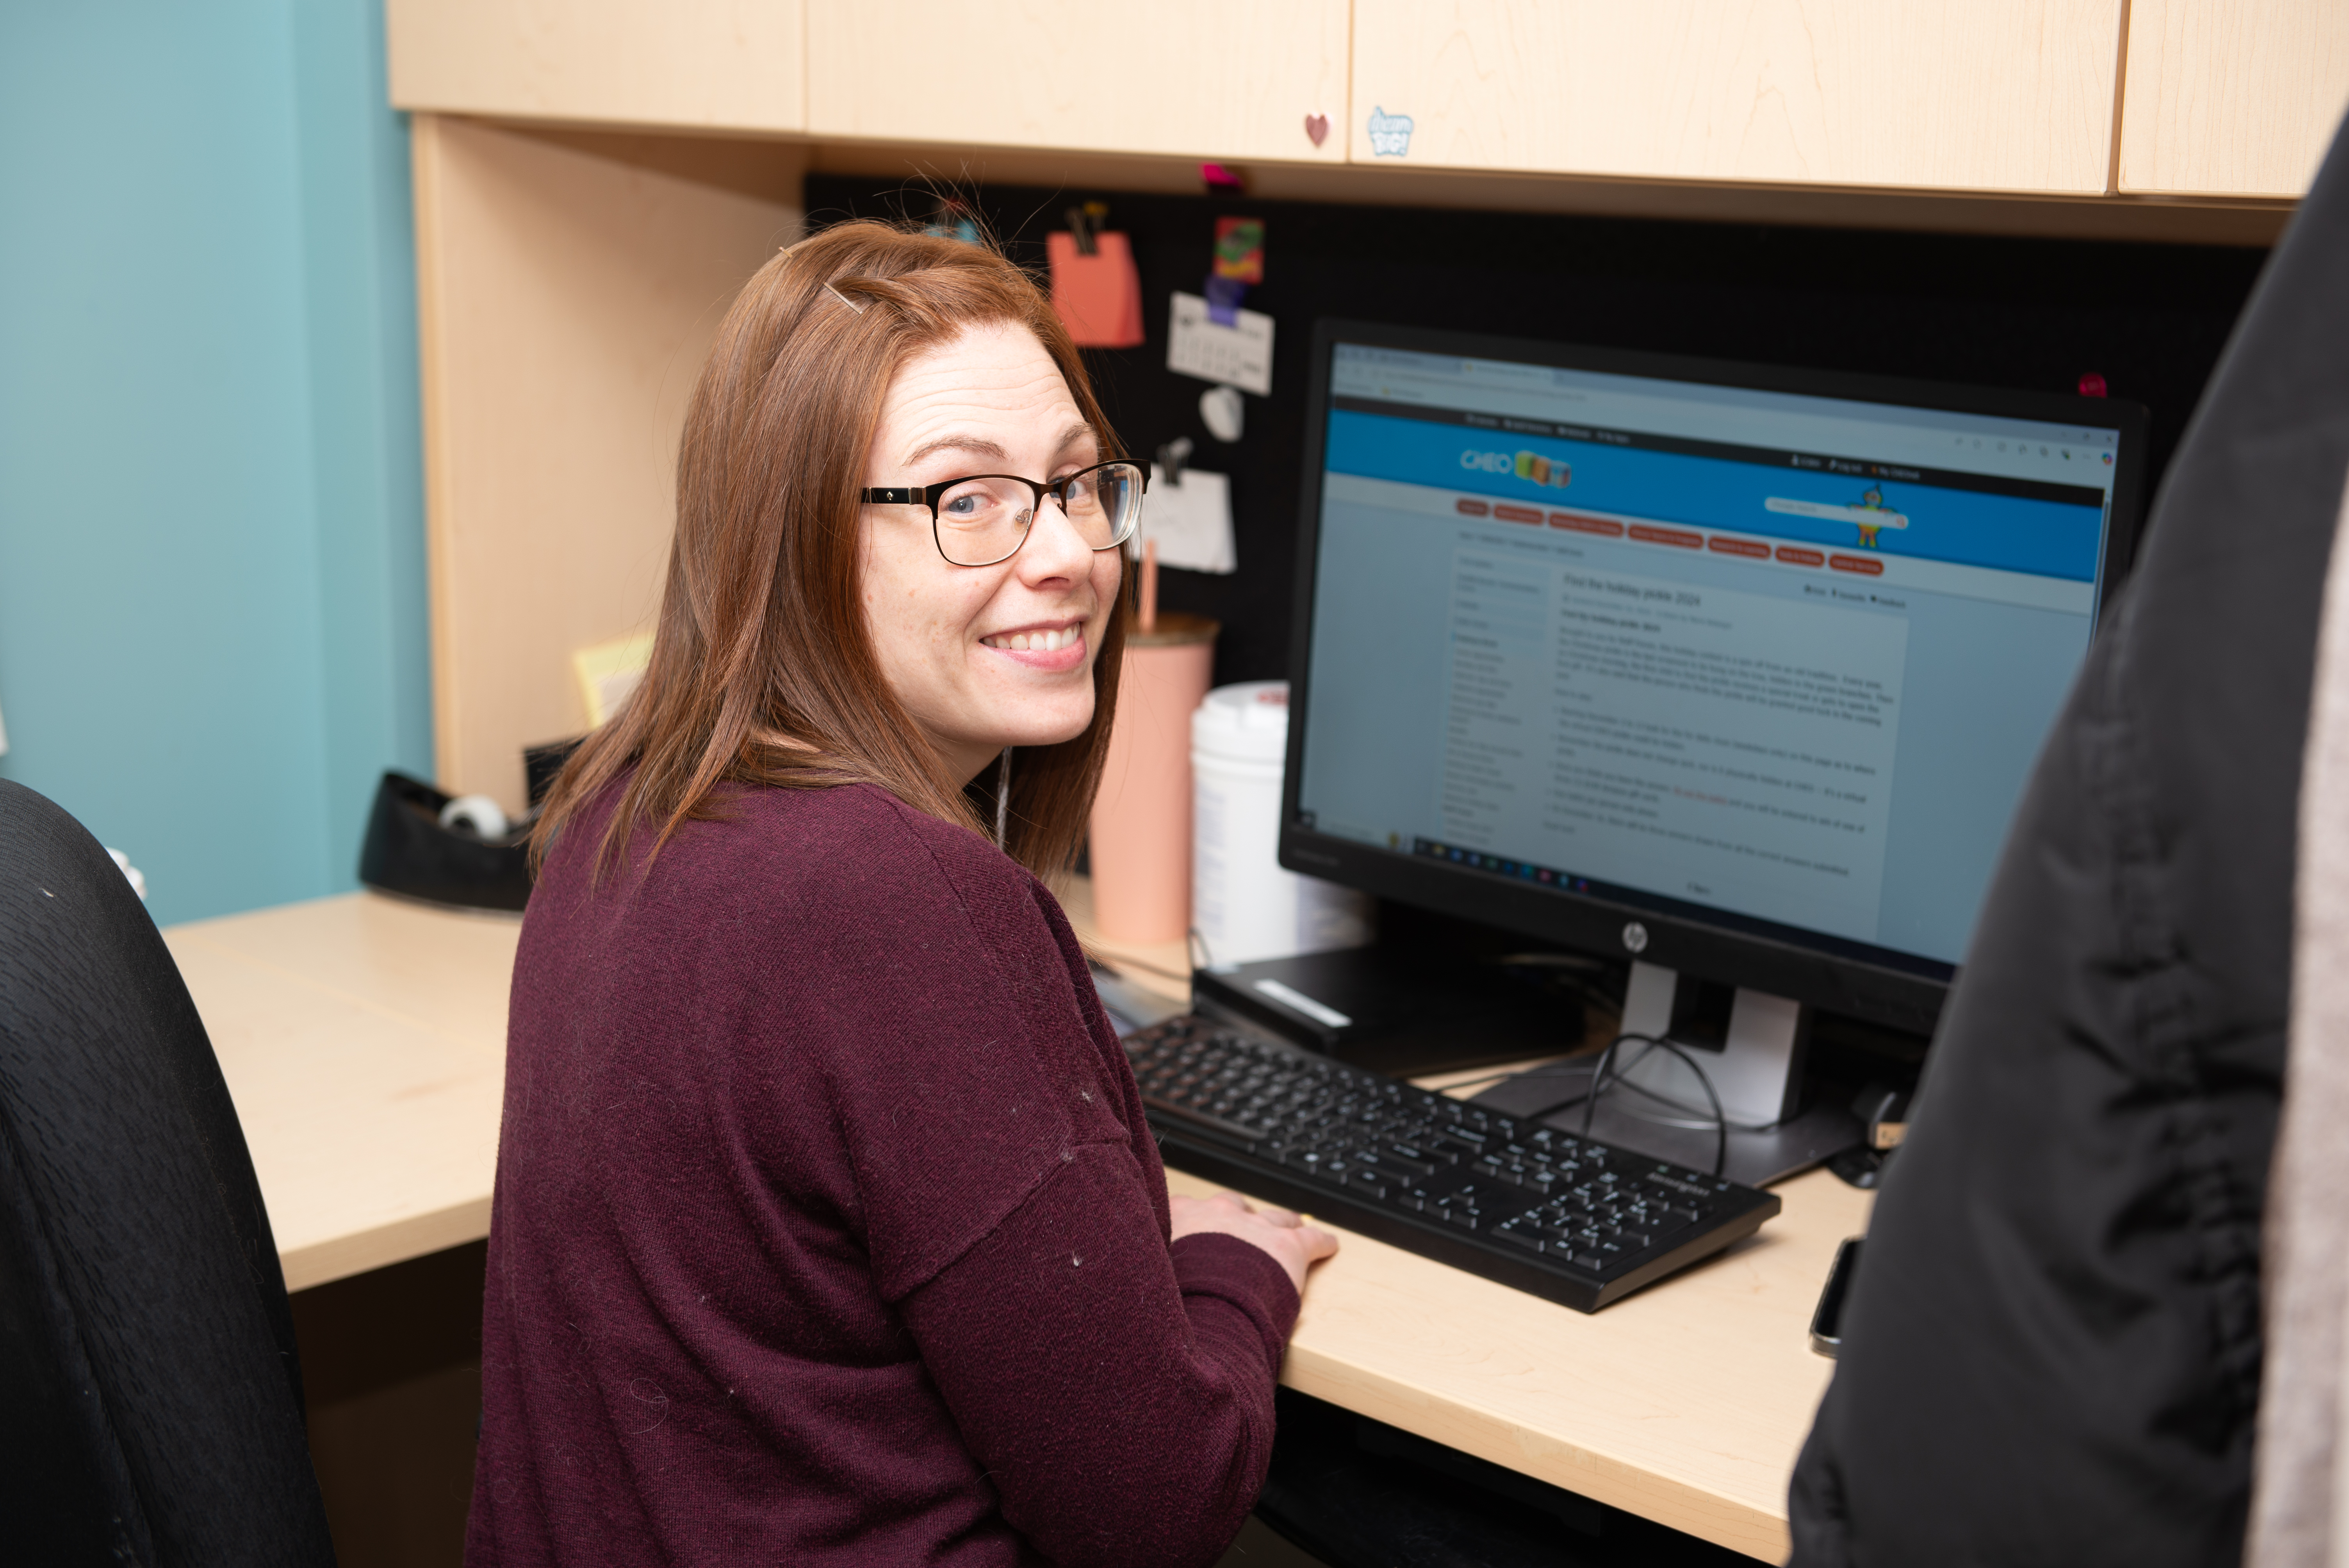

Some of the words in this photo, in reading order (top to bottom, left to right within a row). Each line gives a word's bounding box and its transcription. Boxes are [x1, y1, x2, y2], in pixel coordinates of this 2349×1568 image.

[1460, 449, 1511, 474] CHEO
[1563, 574, 1585, 590] Find
[1587, 577, 1603, 593] the
[1604, 580, 1642, 599] holiday
[1643, 586, 1673, 604] pickle
